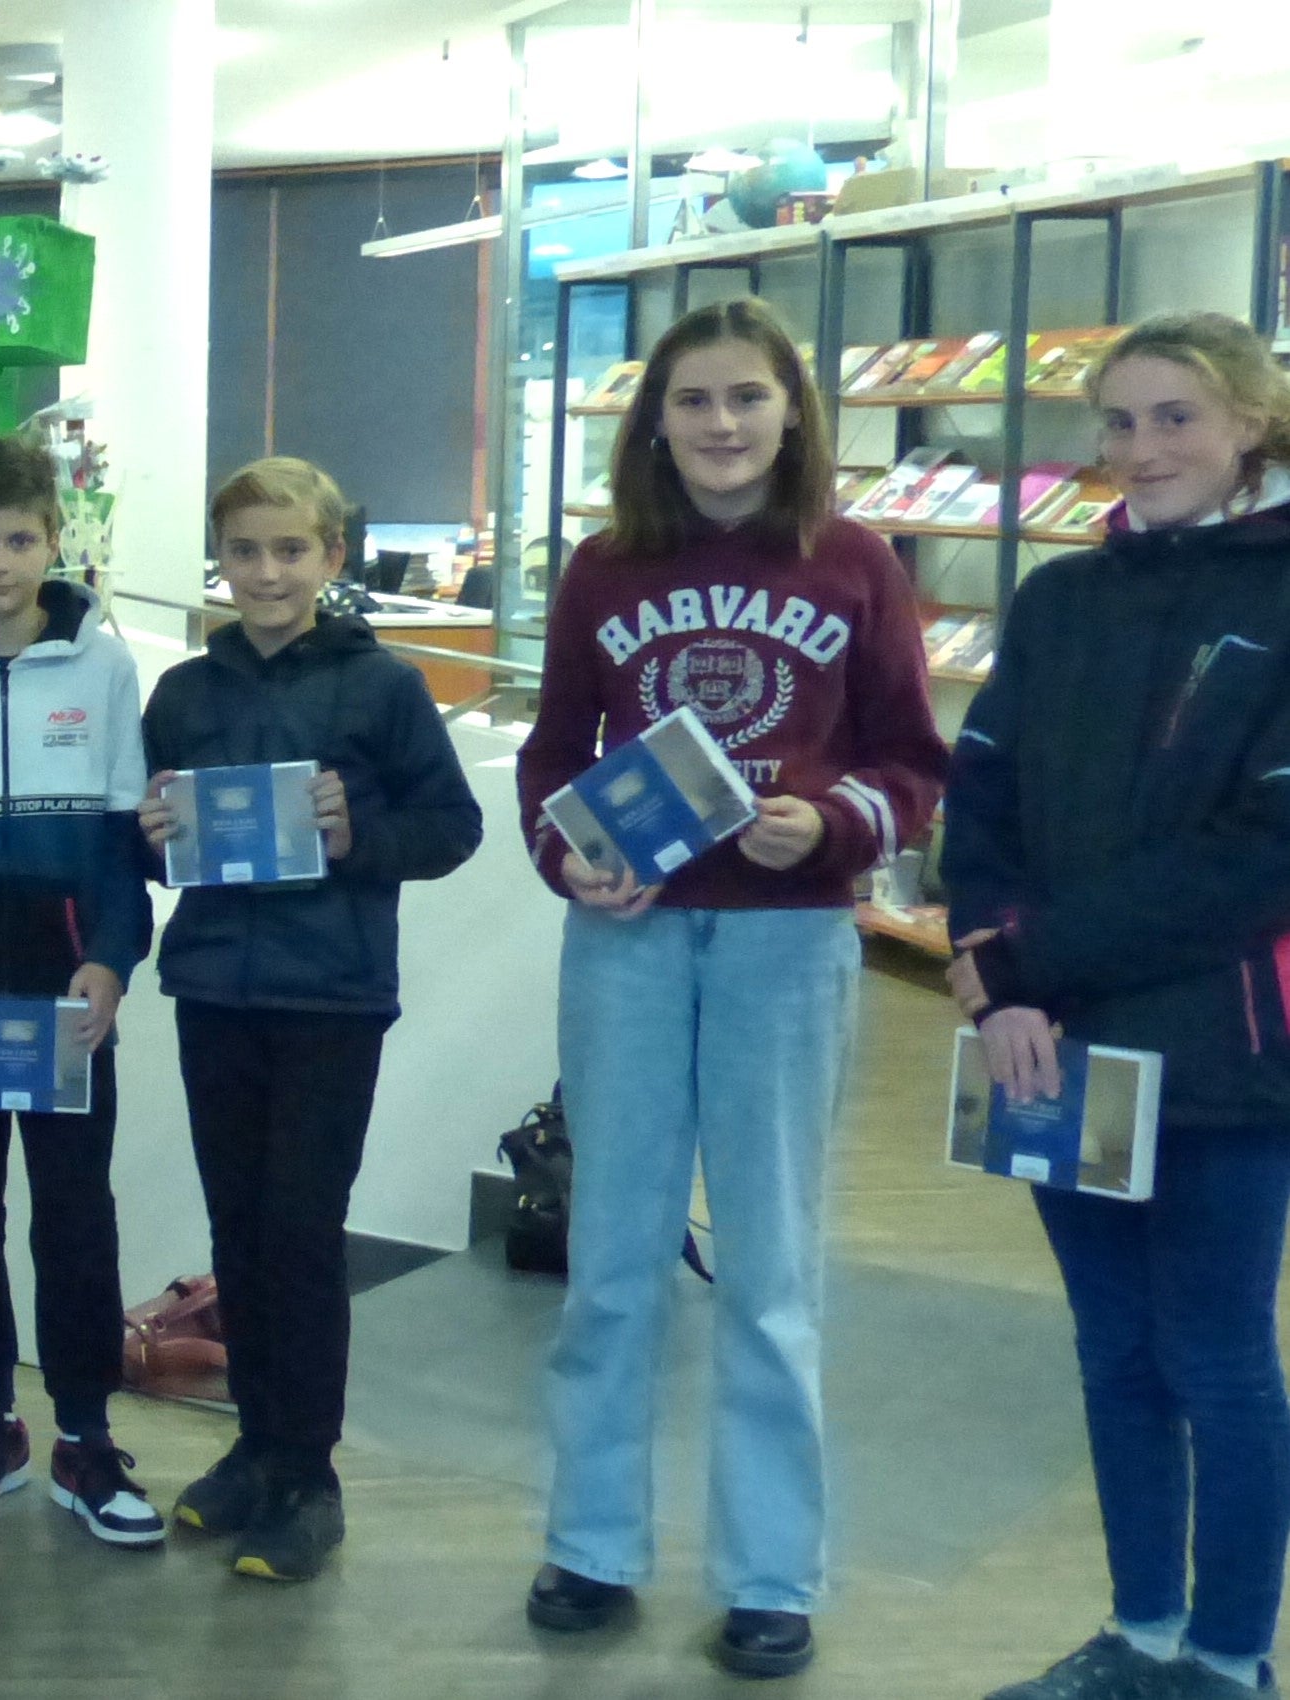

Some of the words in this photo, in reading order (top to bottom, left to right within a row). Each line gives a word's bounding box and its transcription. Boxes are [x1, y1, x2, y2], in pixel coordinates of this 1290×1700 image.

[596, 584, 850, 666] HARVARD
[15, 800, 42, 812] STOP
[43, 799, 70, 811] PLAY
